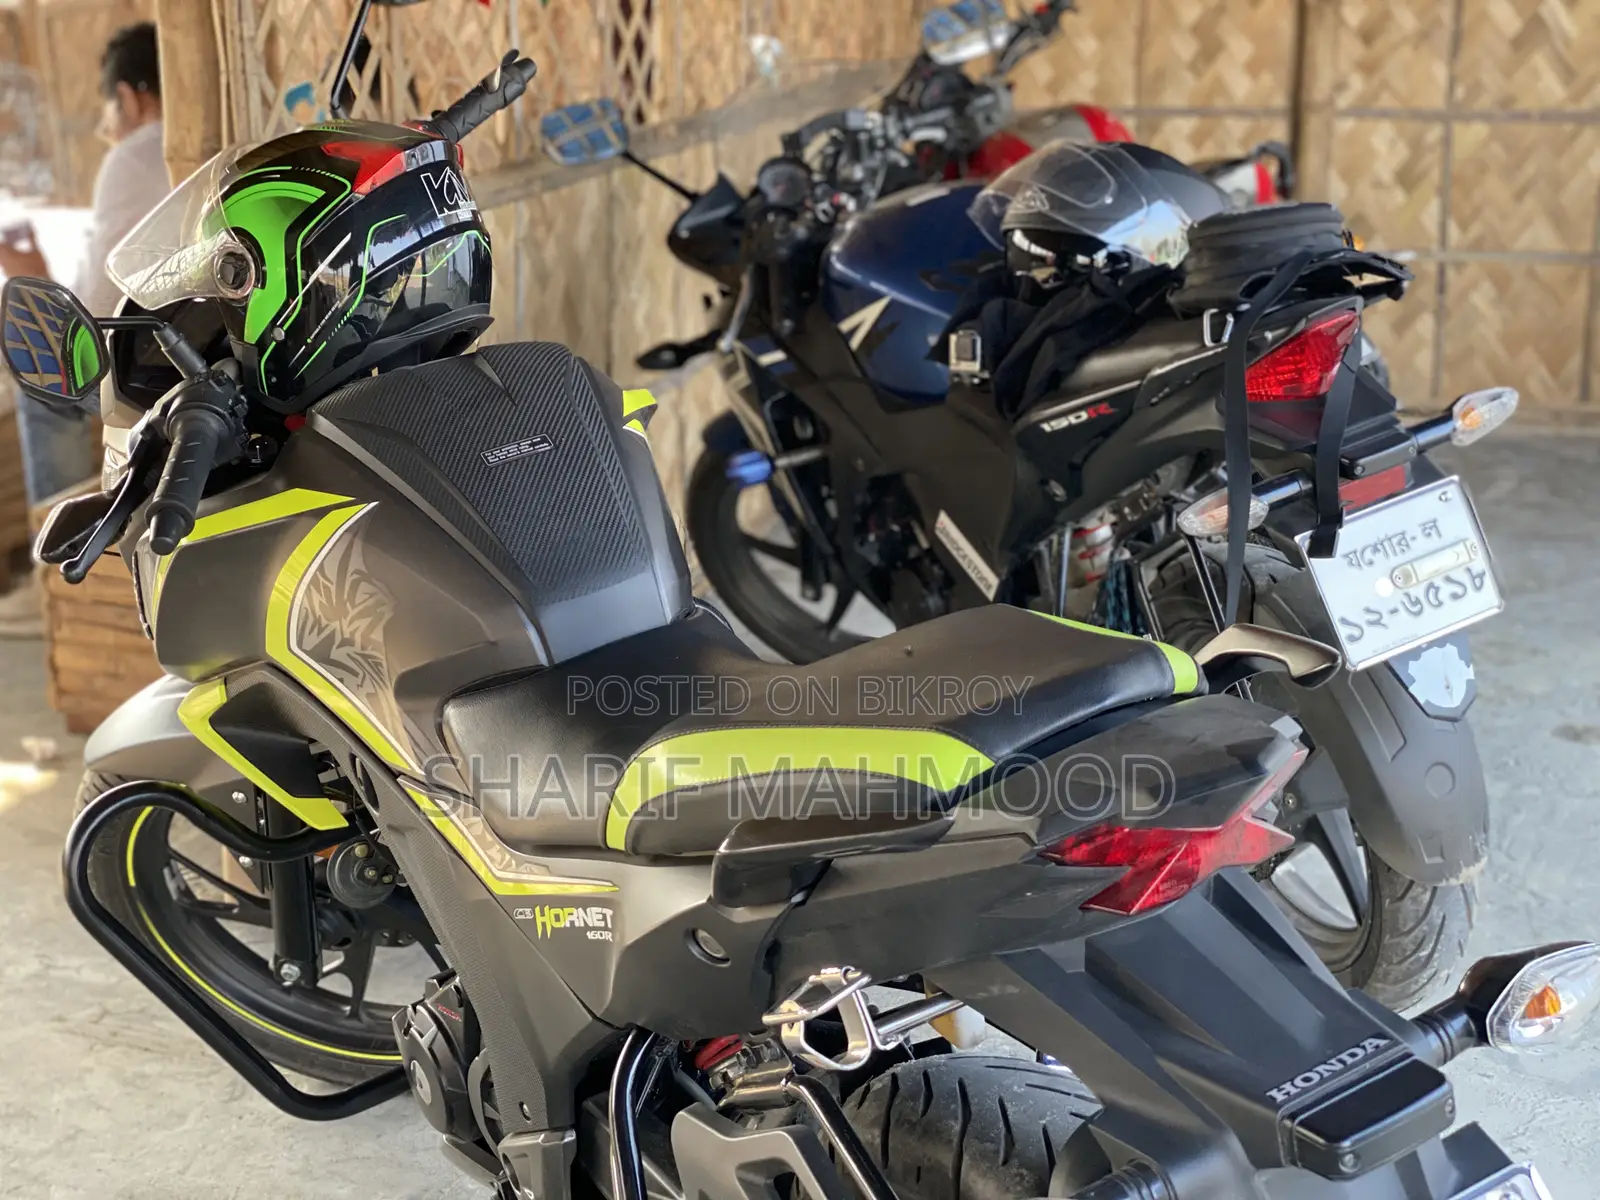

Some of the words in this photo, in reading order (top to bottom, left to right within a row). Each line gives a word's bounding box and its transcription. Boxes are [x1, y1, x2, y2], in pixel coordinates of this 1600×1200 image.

[534, 904, 614, 940] HORNET
[586, 930, 614, 942] 160R
[1265, 1037, 1392, 1104] HONDA
